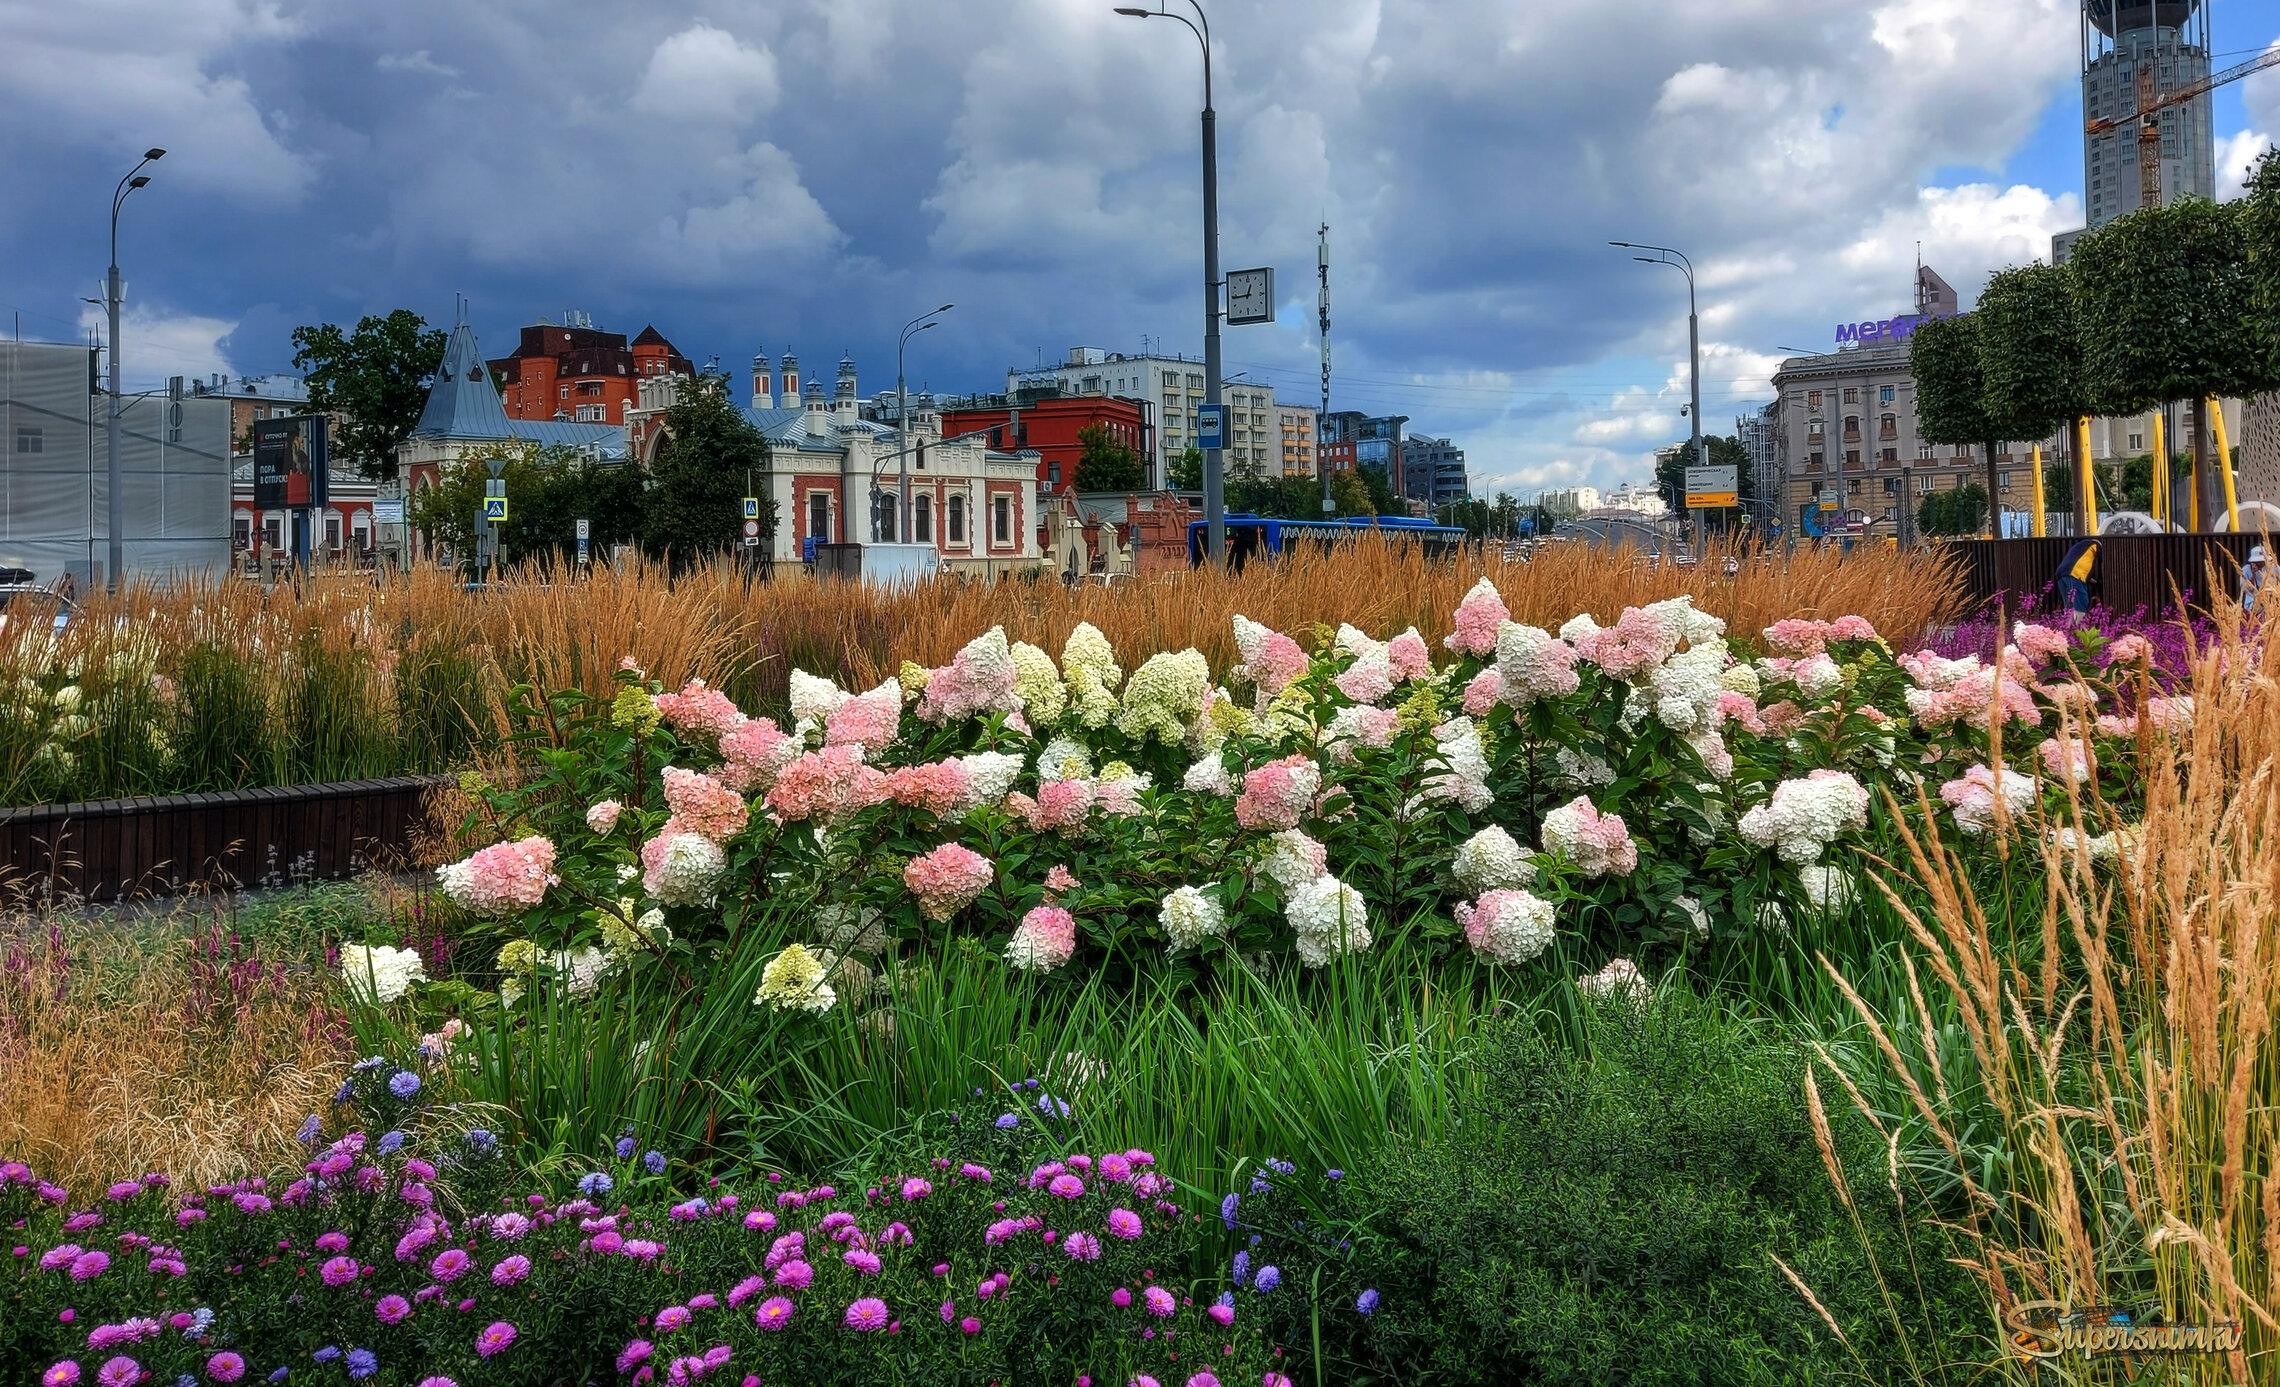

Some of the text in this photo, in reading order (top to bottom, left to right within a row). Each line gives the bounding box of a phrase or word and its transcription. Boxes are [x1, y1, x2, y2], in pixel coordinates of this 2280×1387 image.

[260, 465, 276, 474] ПОРА
[260, 475, 288, 485] В ОТПУСК!
